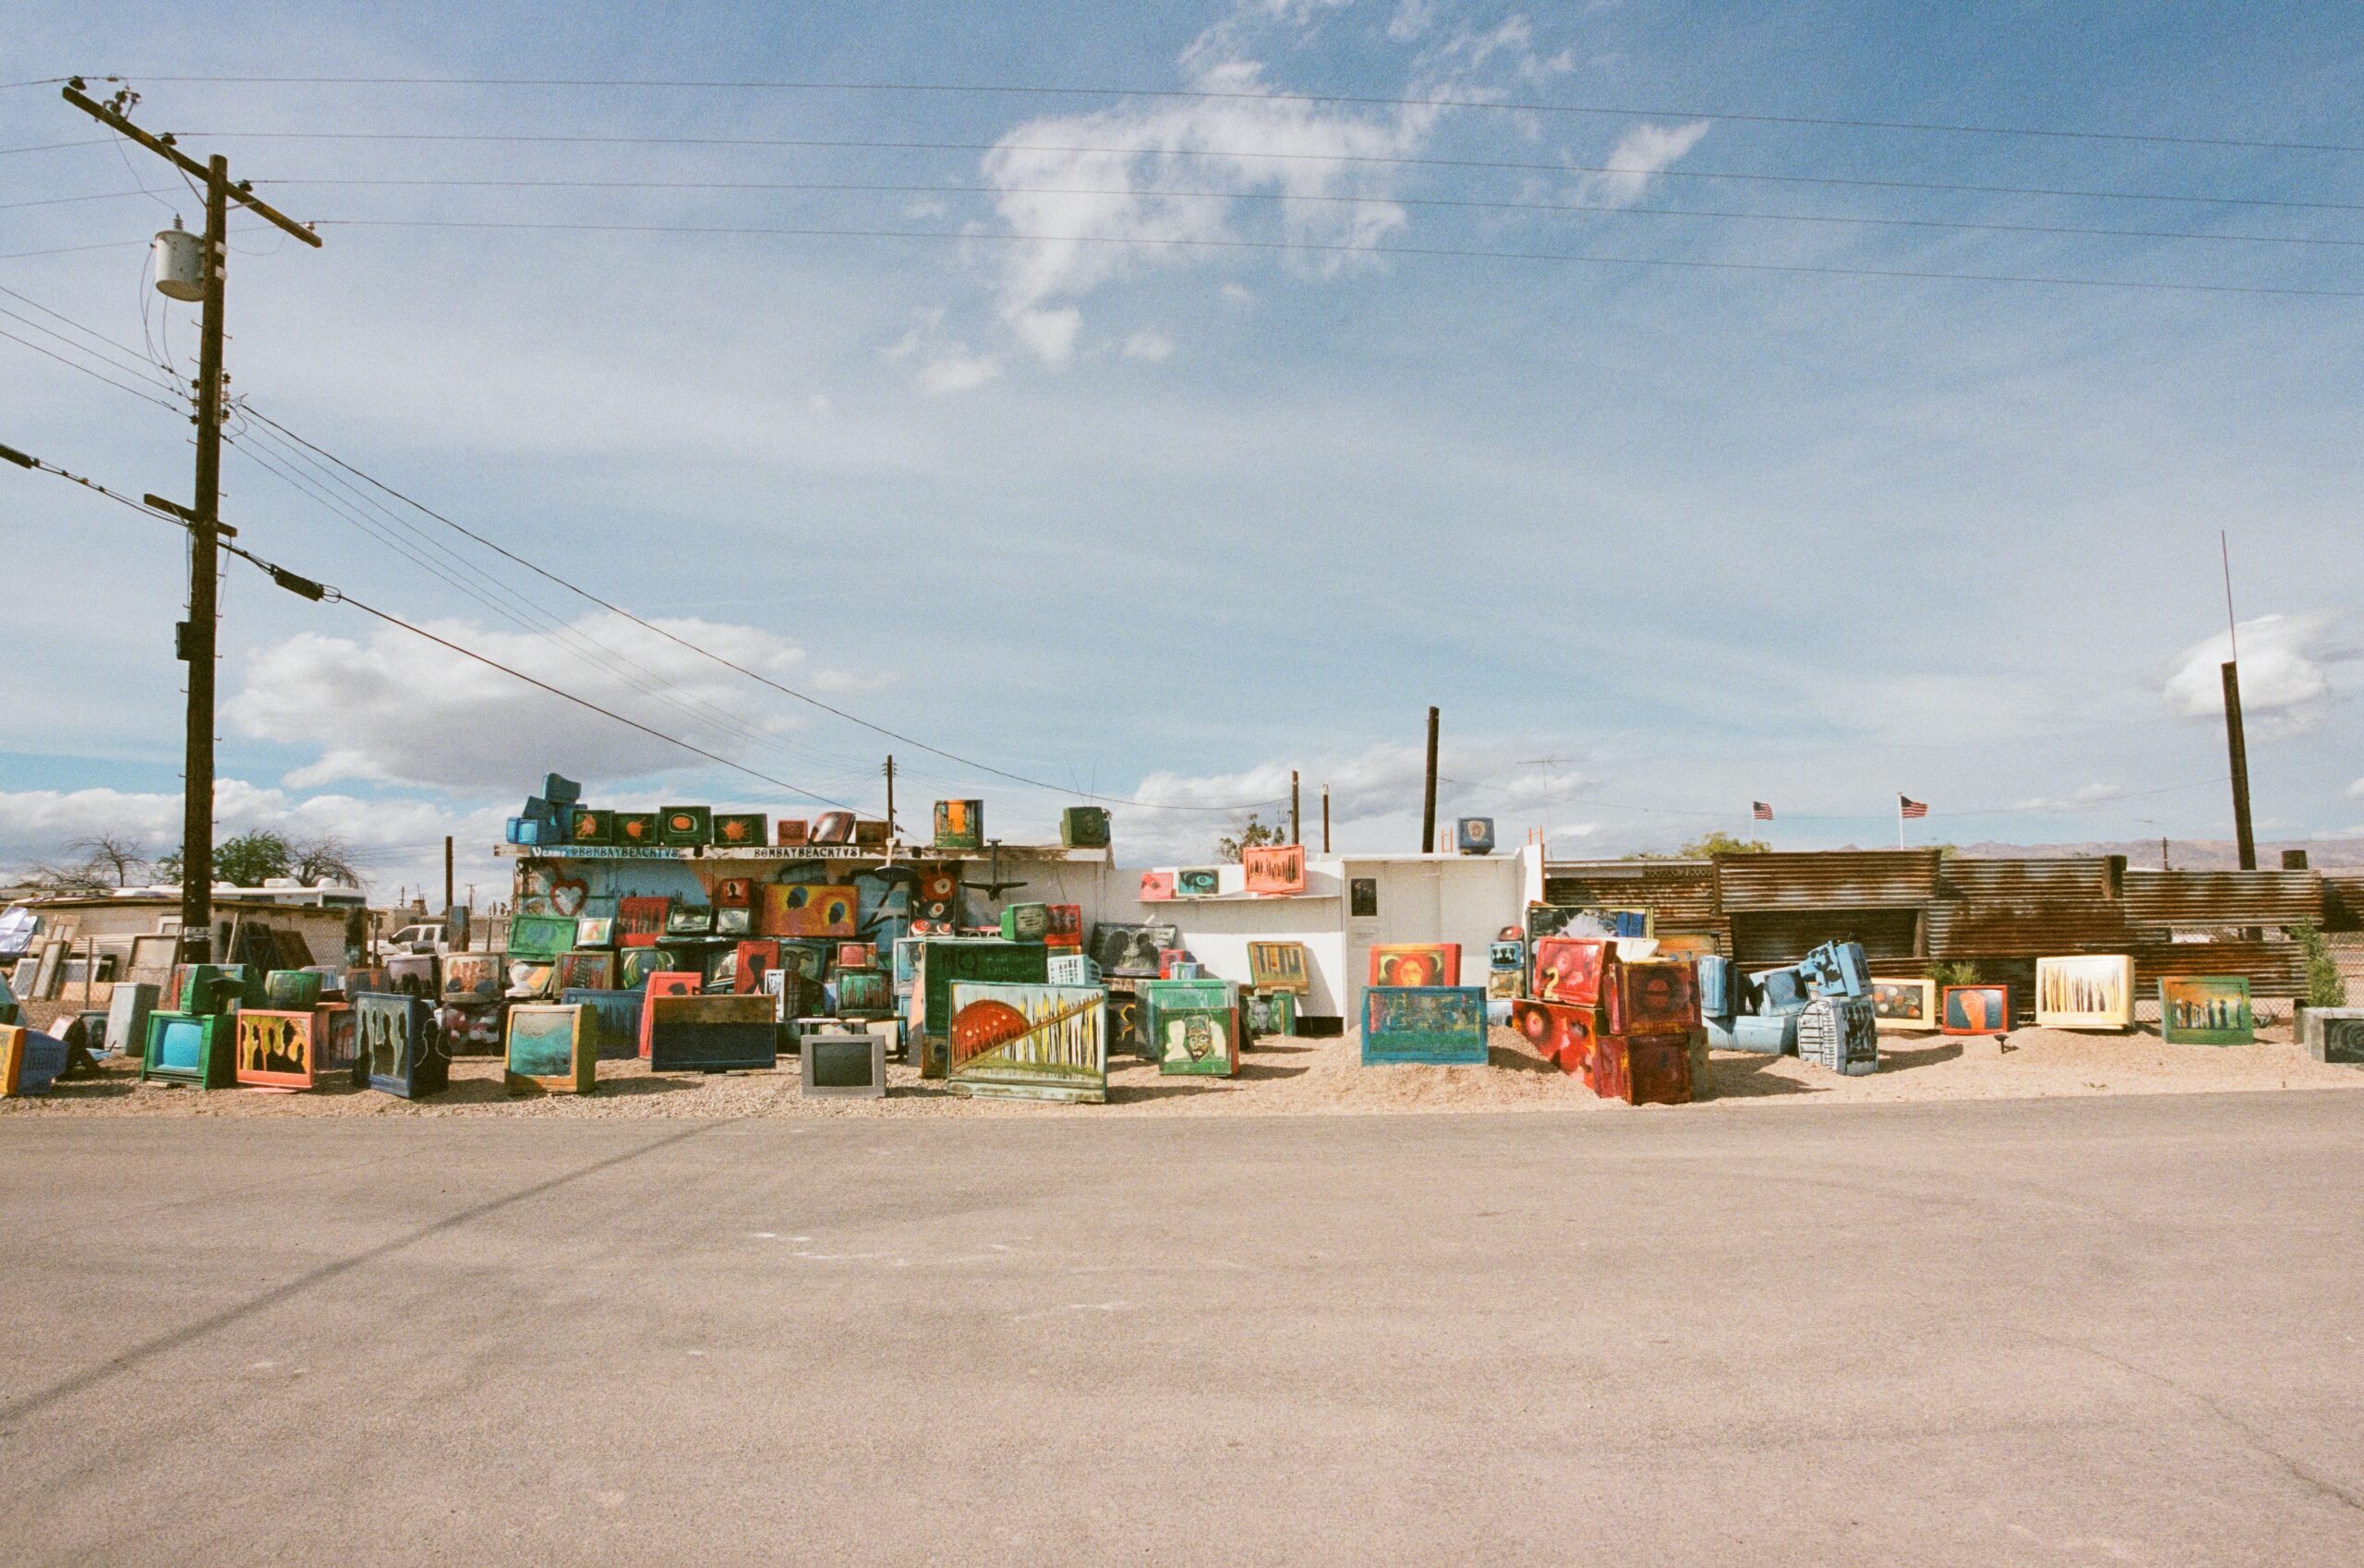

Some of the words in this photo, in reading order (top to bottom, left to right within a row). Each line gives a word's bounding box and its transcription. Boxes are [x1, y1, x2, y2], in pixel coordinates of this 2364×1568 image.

[532, 846, 566, 857] Venmo
[754, 848, 857, 858] BOMBAYBEACHTVS
[1543, 966, 1560, 1001] 2
